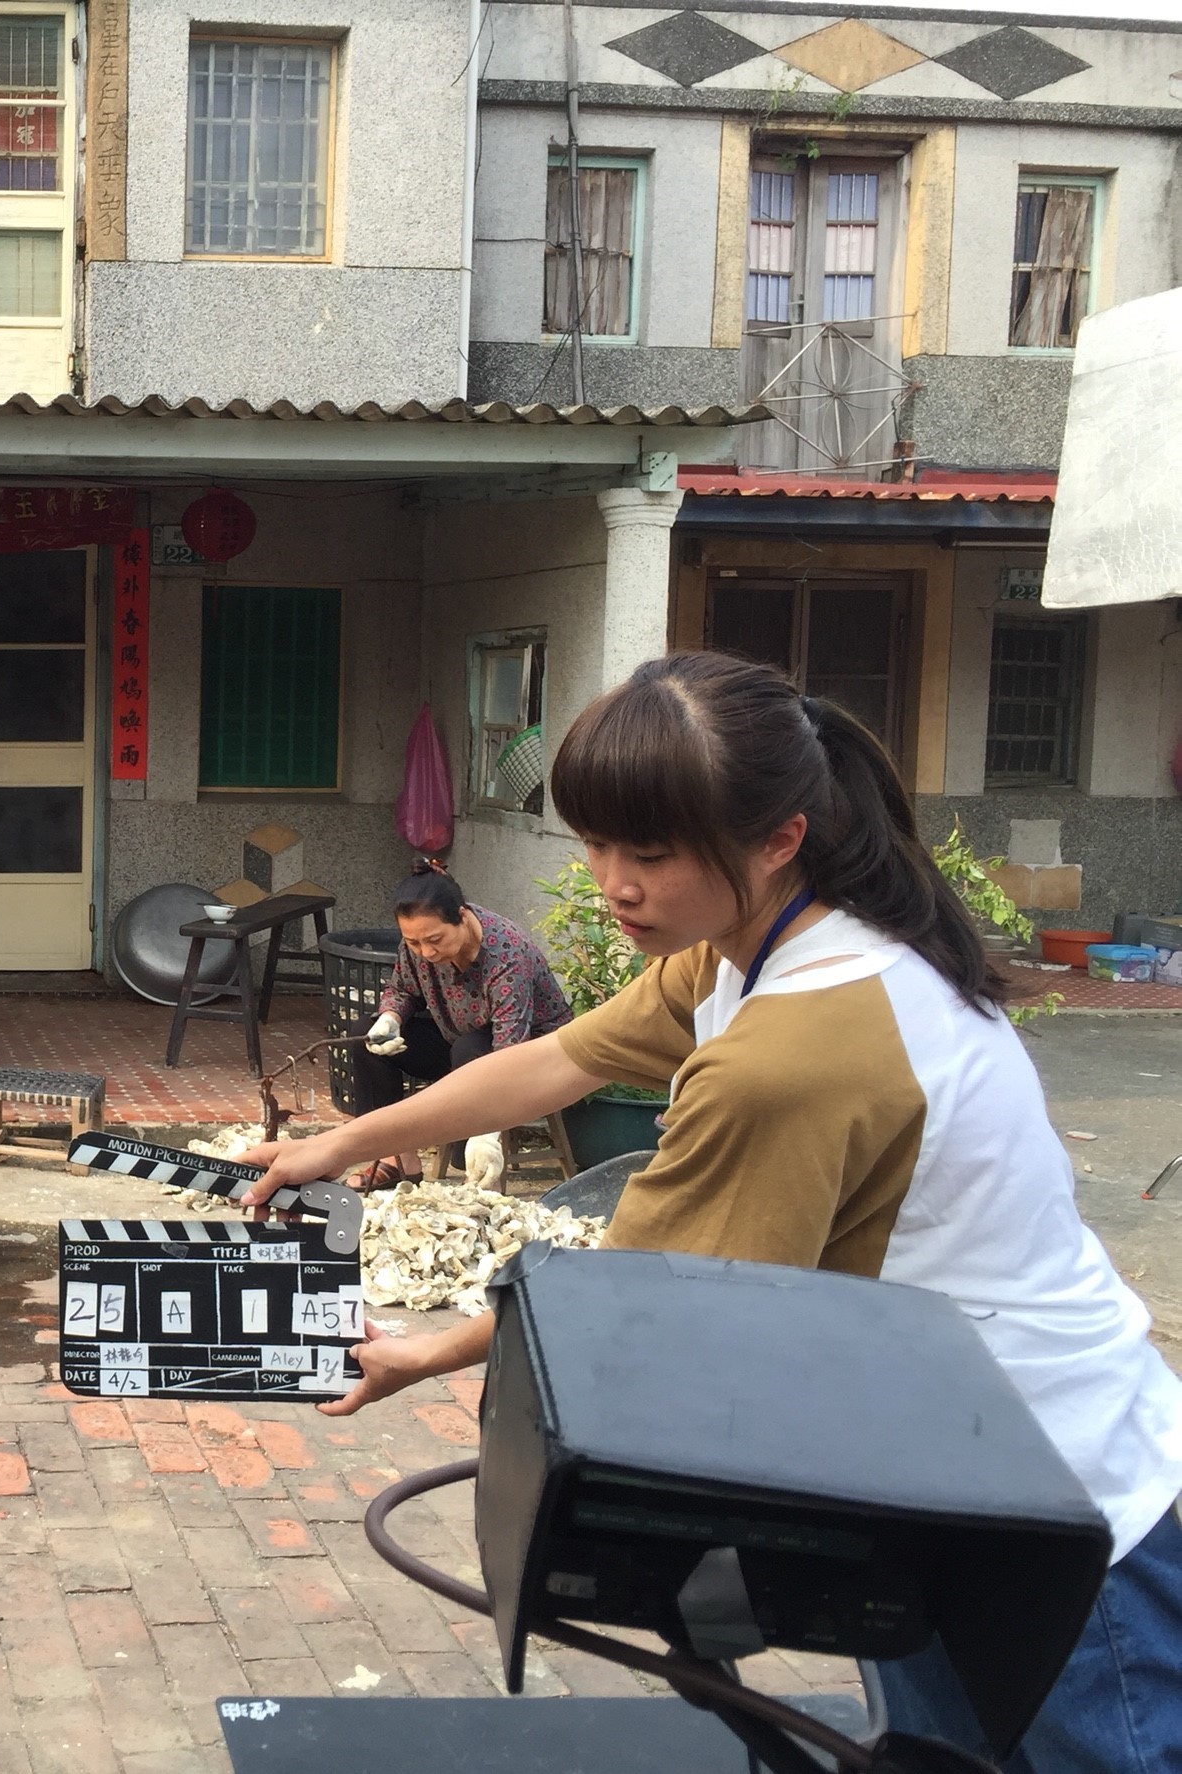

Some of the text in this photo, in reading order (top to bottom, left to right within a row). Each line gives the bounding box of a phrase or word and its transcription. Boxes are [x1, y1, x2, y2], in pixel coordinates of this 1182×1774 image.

[108, 1139, 153, 1158] MOTION
[155, 1149, 205, 1168] PICTURE
[64, 1244, 100, 1256] PROD
[211, 1247, 248, 1259] TITLE
[63, 1263, 91, 1271] SCENE
[141, 1264, 162, 1272] SHOT
[223, 1265, 245, 1273] TAKE
[304, 1266, 325, 1274] ROLL
[166, 1299, 186, 1325] A
[301, 1299, 358, 1329] A57
[64, 1351, 100, 1359] DIRECTOR
[211, 1353, 260, 1362] CAMERAMAN
[65, 1369, 97, 1382] DATE
[169, 1370, 192, 1381] DAY
[261, 1373, 291, 1384] SYNC
[108, 1371, 141, 1392] 4/2
